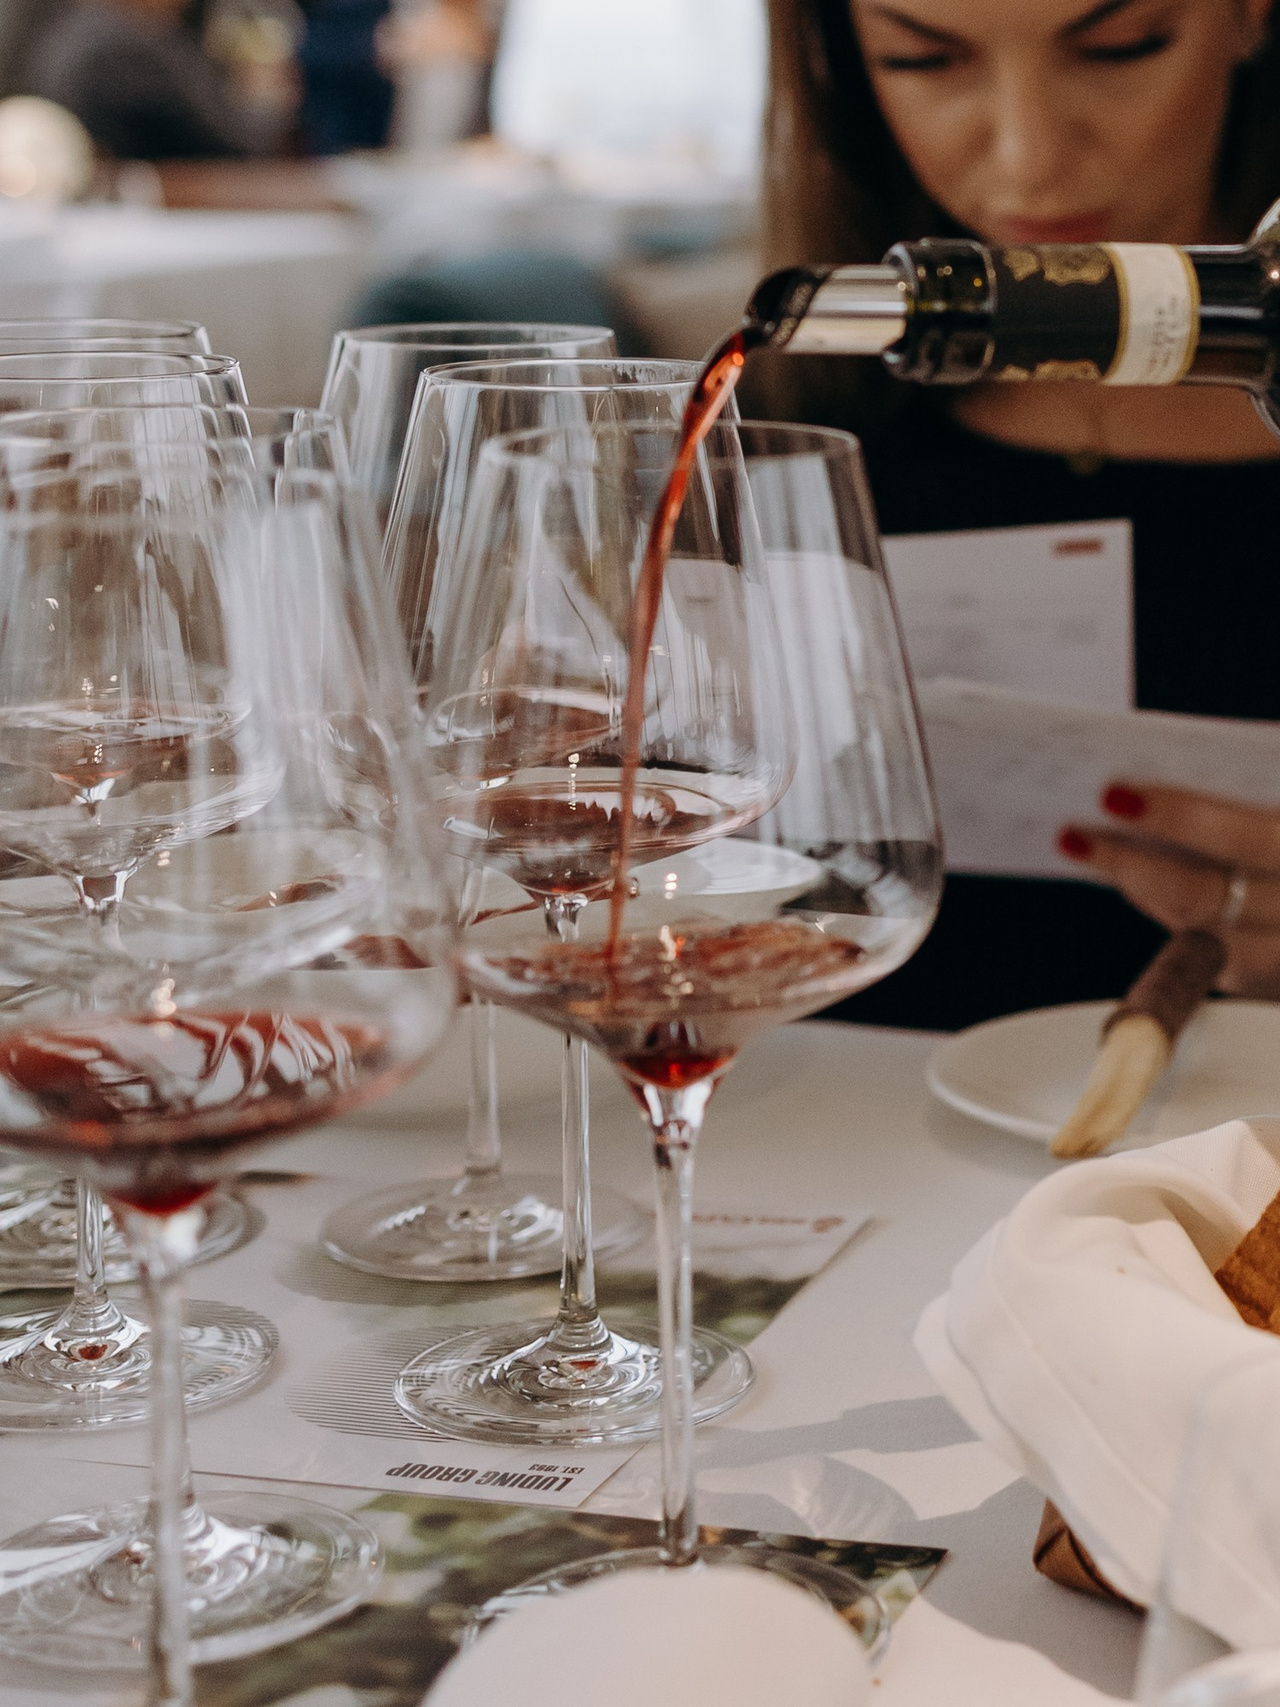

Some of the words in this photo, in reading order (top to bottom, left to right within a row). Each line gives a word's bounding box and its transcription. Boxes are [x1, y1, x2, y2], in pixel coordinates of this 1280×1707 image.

[385, 1462, 479, 1483] GROUP
[559, 1464, 585, 1475] EST.
[474, 1470, 575, 1492] LUDING
